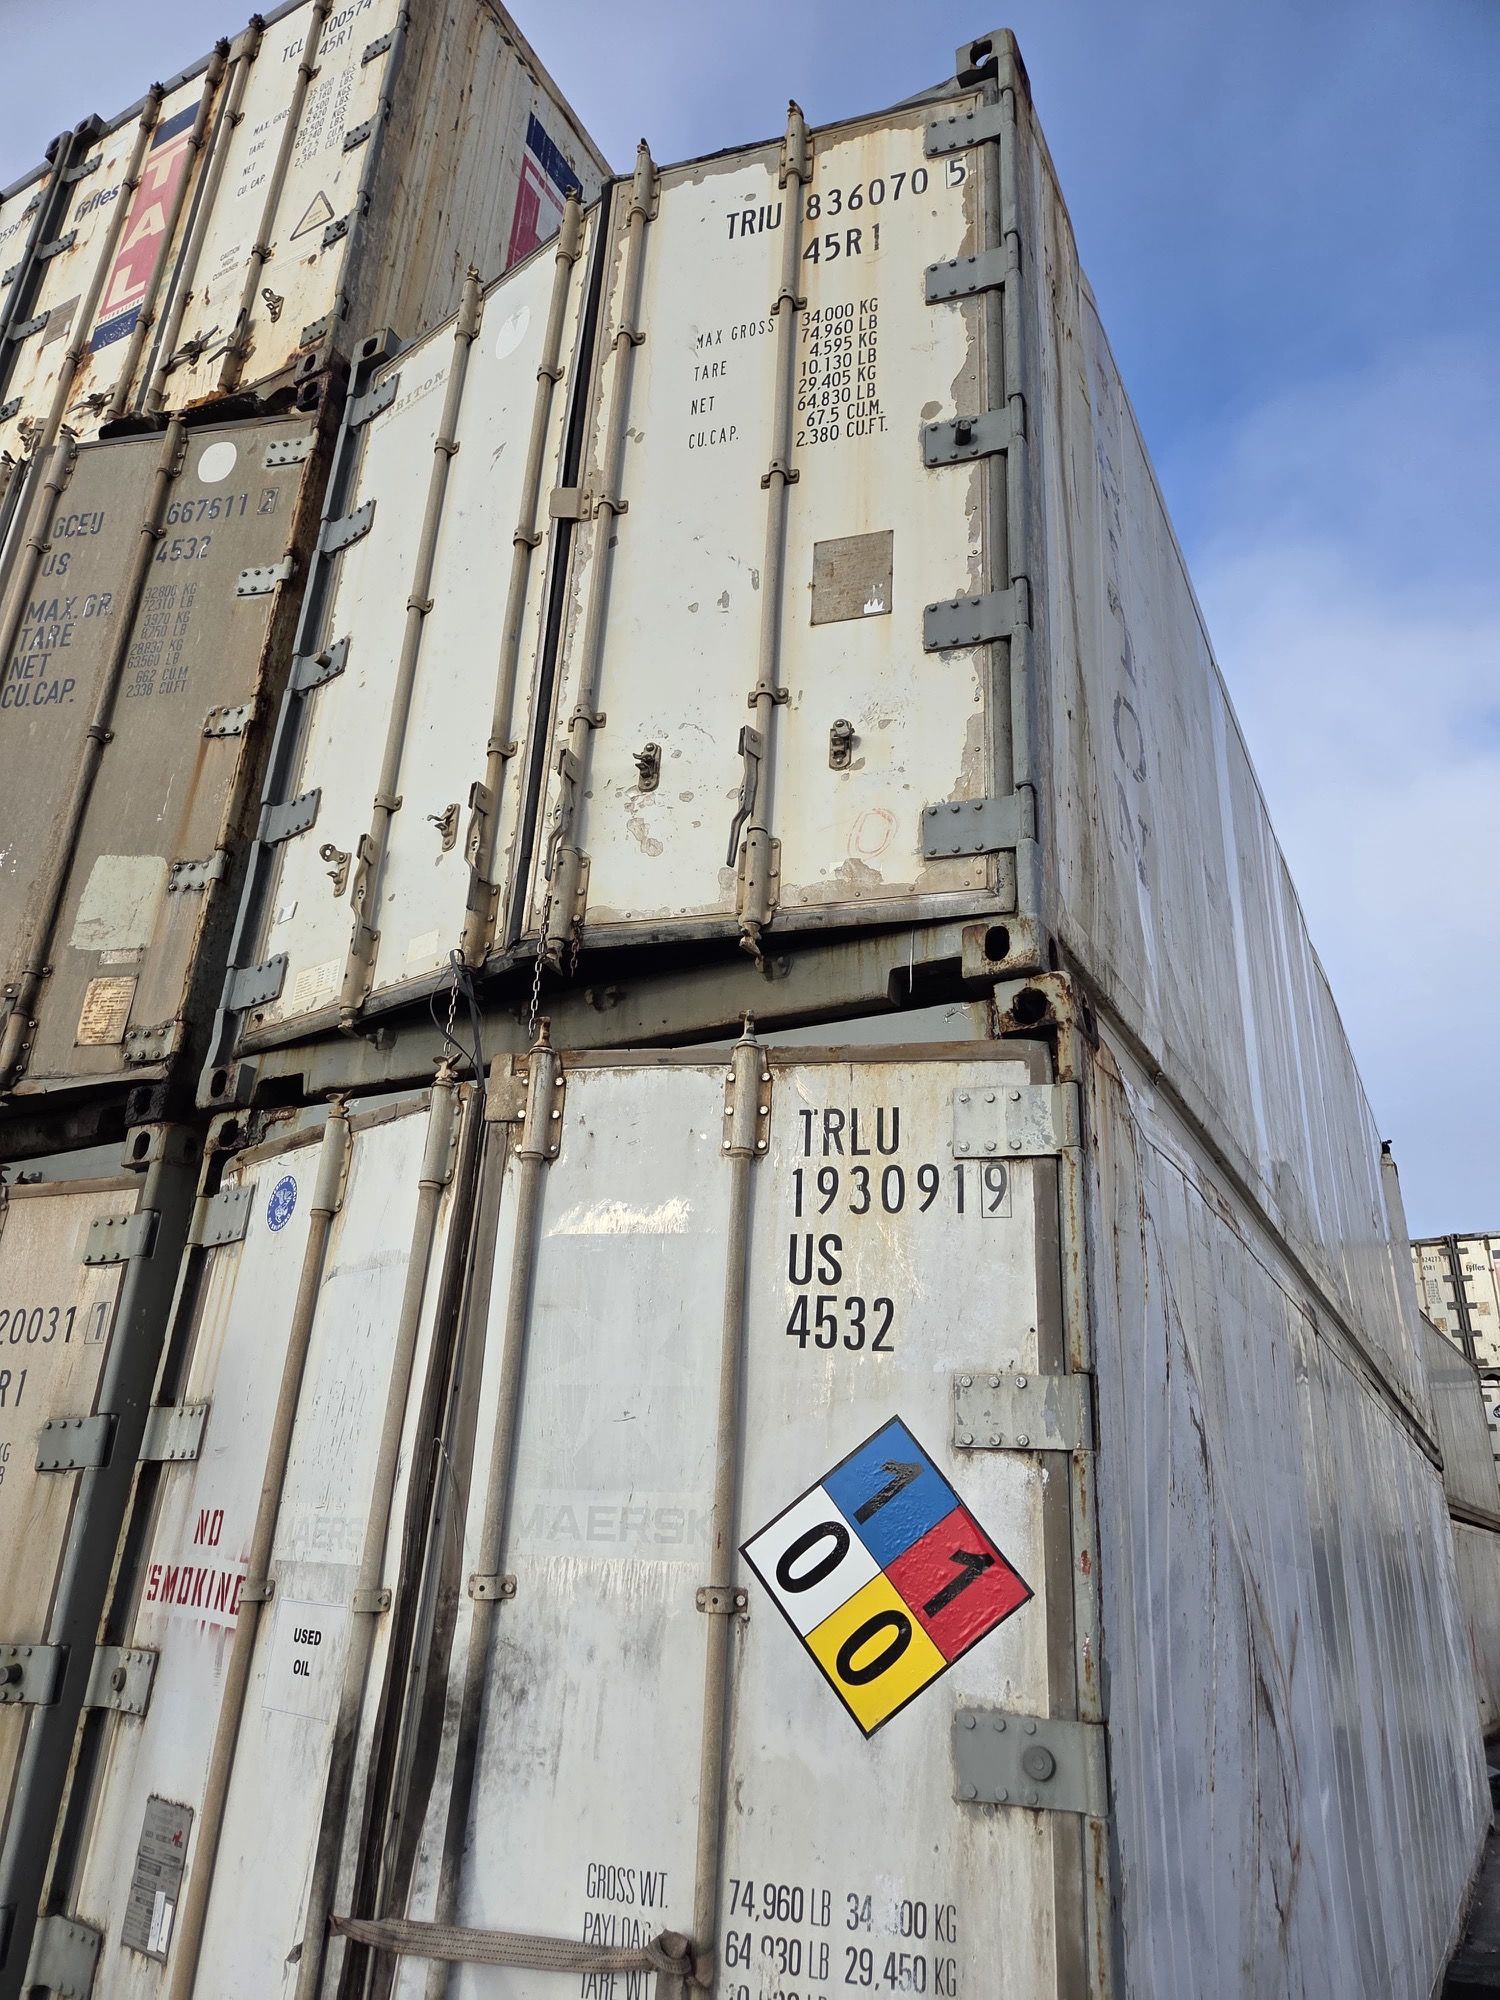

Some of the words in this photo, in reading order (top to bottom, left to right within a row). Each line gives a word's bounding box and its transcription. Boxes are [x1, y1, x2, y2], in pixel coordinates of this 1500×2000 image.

[282, 38, 305, 62] TCL
[322, 0, 372, 36] 100574
[319, 25, 354, 56] 45R1
[272, 106, 292, 124] GROS
[248, 139, 267, 157] TARE
[242, 162, 257, 177] NET
[726, 201, 783, 240] TRIU
[804, 167, 929, 221] 836070
[949, 158, 967, 187] 5
[802, 222, 881, 265] 45R1
[859, 297, 879, 315] KG
[695, 328, 724, 351] MAX
[731, 318, 775, 341] GROSS
[858, 313, 879, 331] LB
[858, 330, 878, 348] KG
[694, 360, 727, 382] TARE
[857, 348, 877, 366] LB
[857, 364, 877, 383] KG
[856, 381, 876, 400] LB
[690, 396, 716, 416] NET
[806, 406, 840, 428] 67.5
[846, 399, 884, 421] CU.M.
[688, 425, 740, 450] CU.CAP.
[845, 415, 888, 438] CU.FT.
[52, 511, 105, 539] GCEU
[166, 492, 249, 526] 667611
[258, 488, 277, 514] 2
[41, 552, 72, 578] US
[155, 535, 212, 563] 4532
[180, 595, 194, 609] LB
[183, 582, 198, 595] KG
[172, 623, 187, 637] LB
[175, 610, 191, 624] KG
[18, 623, 75, 652] TARE
[168, 638, 184, 652] KG
[8, 653, 52, 682] NET
[165, 651, 180, 666] LB
[1, 679, 75, 709] CU.CAP.
[798, 1105, 901, 1158] TRLU
[786, 1233, 843, 1287] US
[0, 1306, 77, 1345] 20031
[785, 1294, 896, 1352] 4532
[854, 1458, 924, 1526] 1
[193, 1508, 225, 1547] NO
[775, 1521, 852, 1595] 0
[922, 1547, 997, 1619] 1
[147, 1564, 247, 1616] SMOKING
[293, 1627, 323, 1646] USED
[836, 1608, 913, 1687] 0
[293, 1659, 311, 1677] OIL
[586, 1862, 636, 1905] GROSS
[639, 1870, 669, 1909] WT.
[728, 1878, 805, 1923] 74,960
[810, 1887, 832, 1927] LB
[934, 1903, 958, 1944] KG
[808, 1940, 830, 1980] LB
[844, 1945, 927, 1994] 29,450
[934, 1956, 958, 1997] KG
